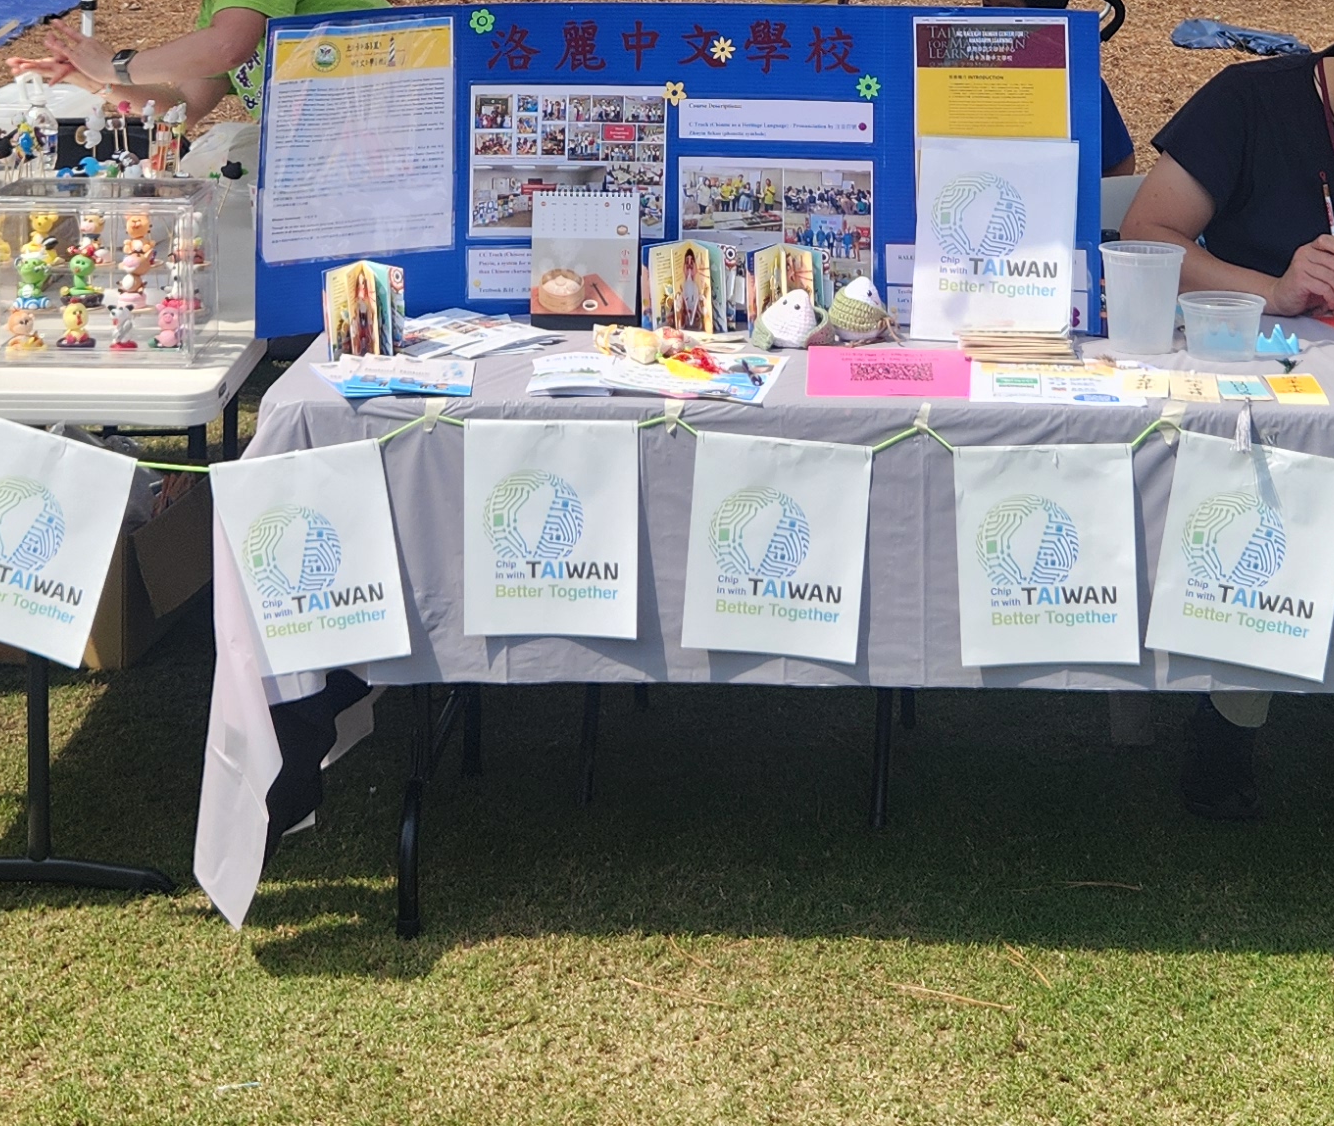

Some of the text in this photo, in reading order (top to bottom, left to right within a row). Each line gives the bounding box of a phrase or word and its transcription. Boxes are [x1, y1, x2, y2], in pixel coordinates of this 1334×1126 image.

[487, 19, 860, 74] 洛麗中文學校
[621, 202, 632, 211] 10
[940, 255, 960, 264] Chip
[939, 266, 968, 274] in with
[968, 257, 1058, 279] TAIWAN
[938, 277, 1056, 298] Better Together
[495, 560, 516, 570] Chip
[526, 561, 619, 580] TAIWAN
[495, 570, 525, 579] in with
[718, 574, 739, 584] Chip
[716, 586, 747, 596] in with
[748, 577, 842, 604] TAIWAN
[1187, 577, 1209, 589] Chip
[291, 582, 384, 614] TAIWAN
[495, 584, 619, 601] Better Together
[991, 587, 1012, 597] Chip
[1021, 586, 1117, 605] TAIWAN
[1185, 589, 1216, 602] in with
[12, 592, 75, 625] Together
[262, 598, 283, 609] Chip
[991, 598, 1021, 607] in with
[1218, 583, 1315, 619] TAIWAN
[263, 608, 293, 620] in with
[716, 599, 840, 623] Better Together
[991, 610, 1118, 626] Better Together
[266, 608, 387, 638] Better Together
[1182, 601, 1310, 639] Better Together
